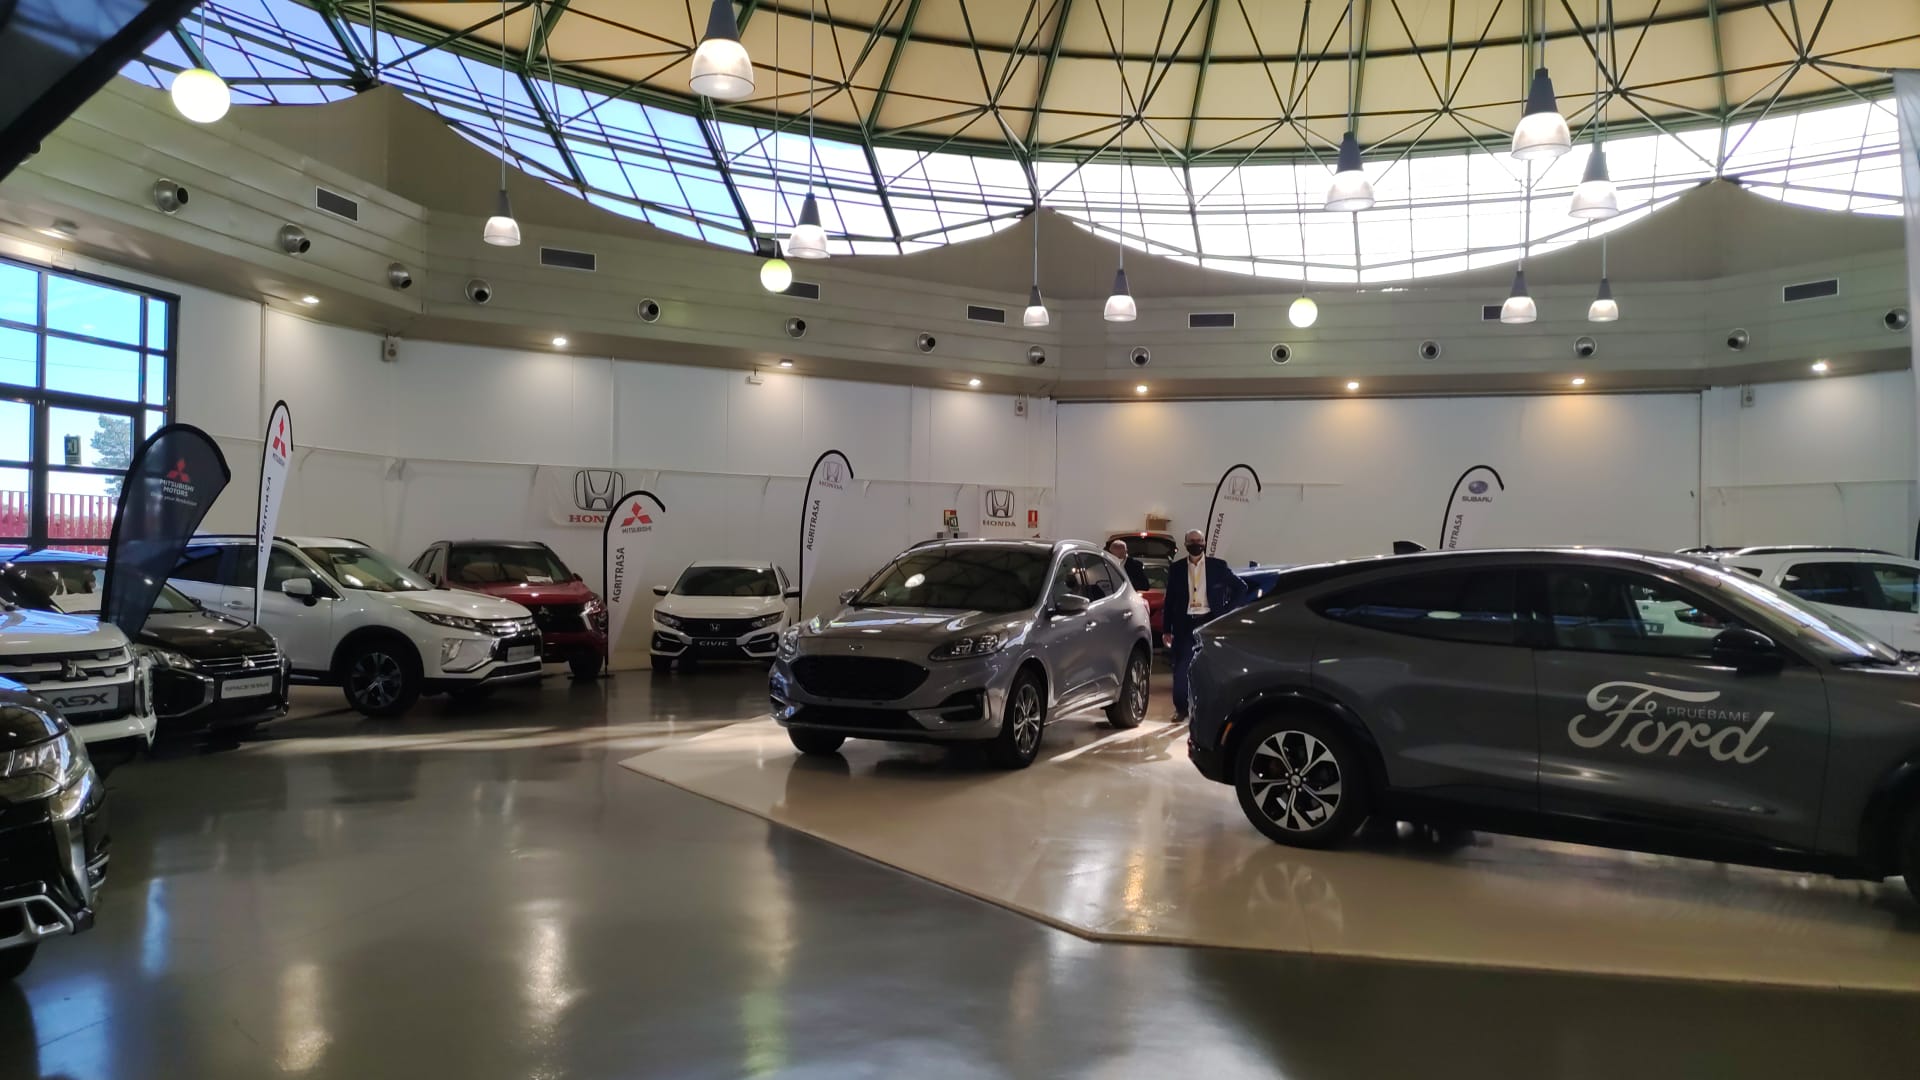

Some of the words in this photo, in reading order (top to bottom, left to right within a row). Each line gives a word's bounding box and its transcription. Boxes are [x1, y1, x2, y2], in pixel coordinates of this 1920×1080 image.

[160, 479, 195, 492] MITSUBISHI
[163, 486, 189, 497] MOTORS
[1462, 495, 1493, 503] SUBARU
[568, 513, 606, 524] HON
[806, 500, 821, 552] AGRITRASA
[982, 519, 1017, 528] HONDA
[1448, 514, 1464, 550] RITRASA
[611, 547, 625, 603] AGRITRASA
[51, 692, 110, 709] ASX
[1567, 681, 1775, 764] Ford
